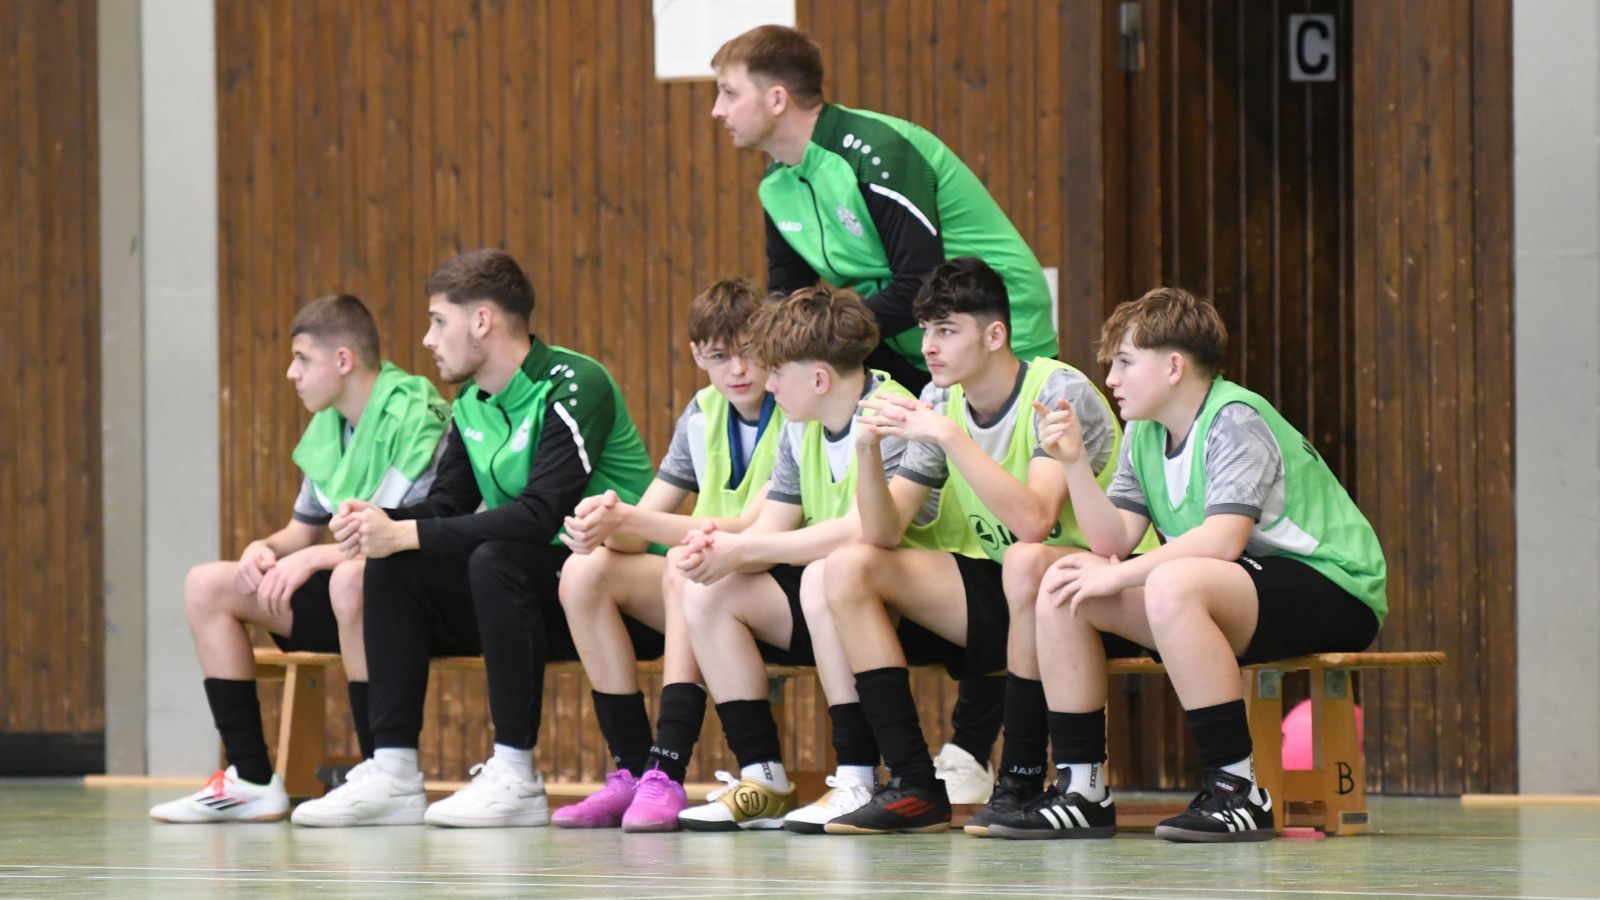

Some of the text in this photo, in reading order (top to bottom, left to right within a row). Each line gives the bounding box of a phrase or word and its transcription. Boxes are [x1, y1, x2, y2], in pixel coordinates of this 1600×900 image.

[1297, 20, 1330, 76] C
[1008, 765, 1042, 776] JAKO
[1335, 762, 1354, 795] B
